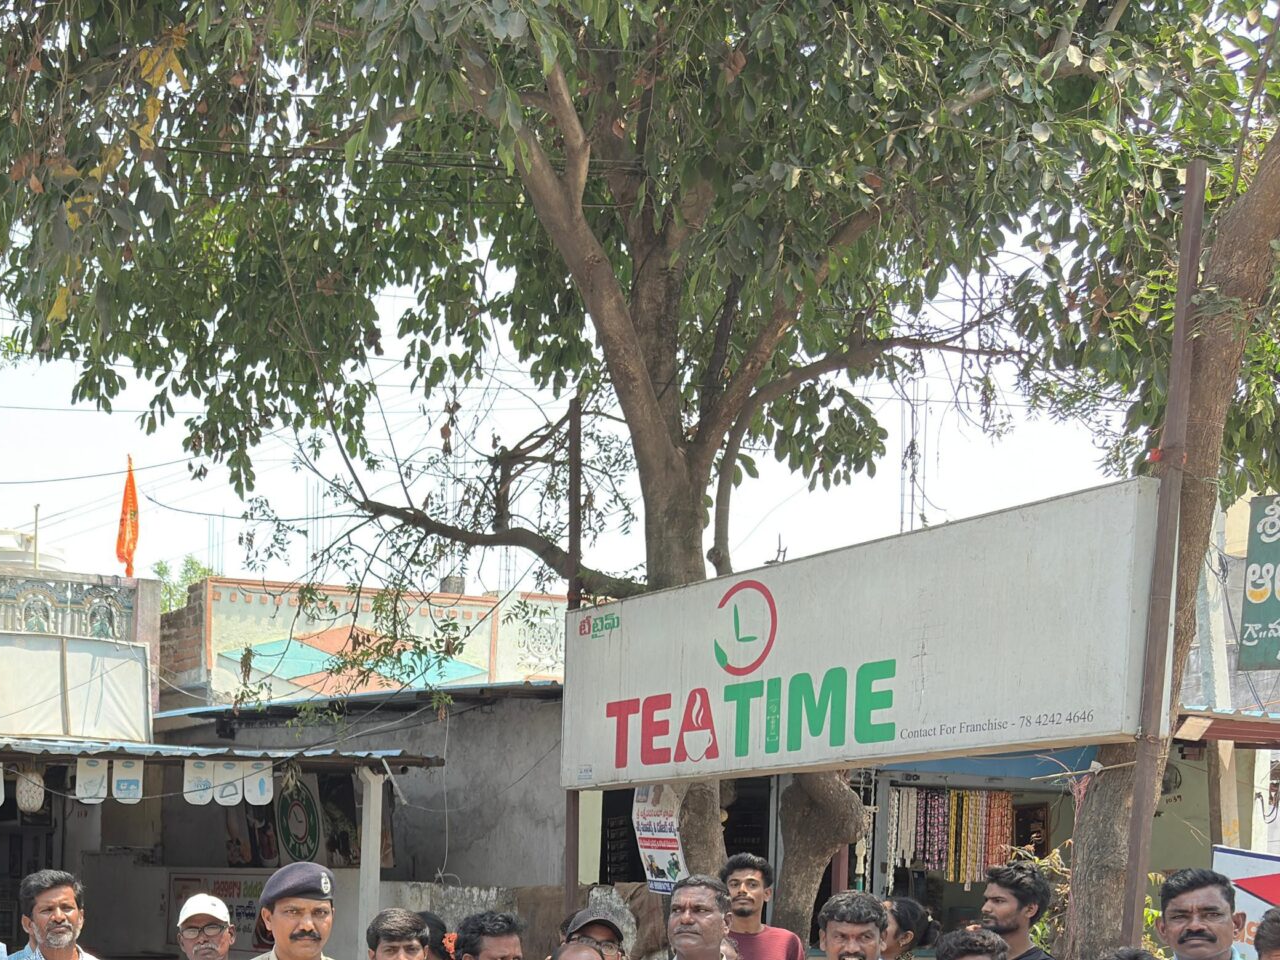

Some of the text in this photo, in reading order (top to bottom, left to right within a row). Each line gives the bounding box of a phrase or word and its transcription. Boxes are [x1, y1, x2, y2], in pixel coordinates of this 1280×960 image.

[900, 724, 936, 740] Contact
[939, 723, 956, 735] For
[959, 718, 1008, 733] Franchise
[1019, 715, 1032, 728] 78
[1035, 712, 1062, 727] 4242
[1065, 709, 1094, 724] 4646
